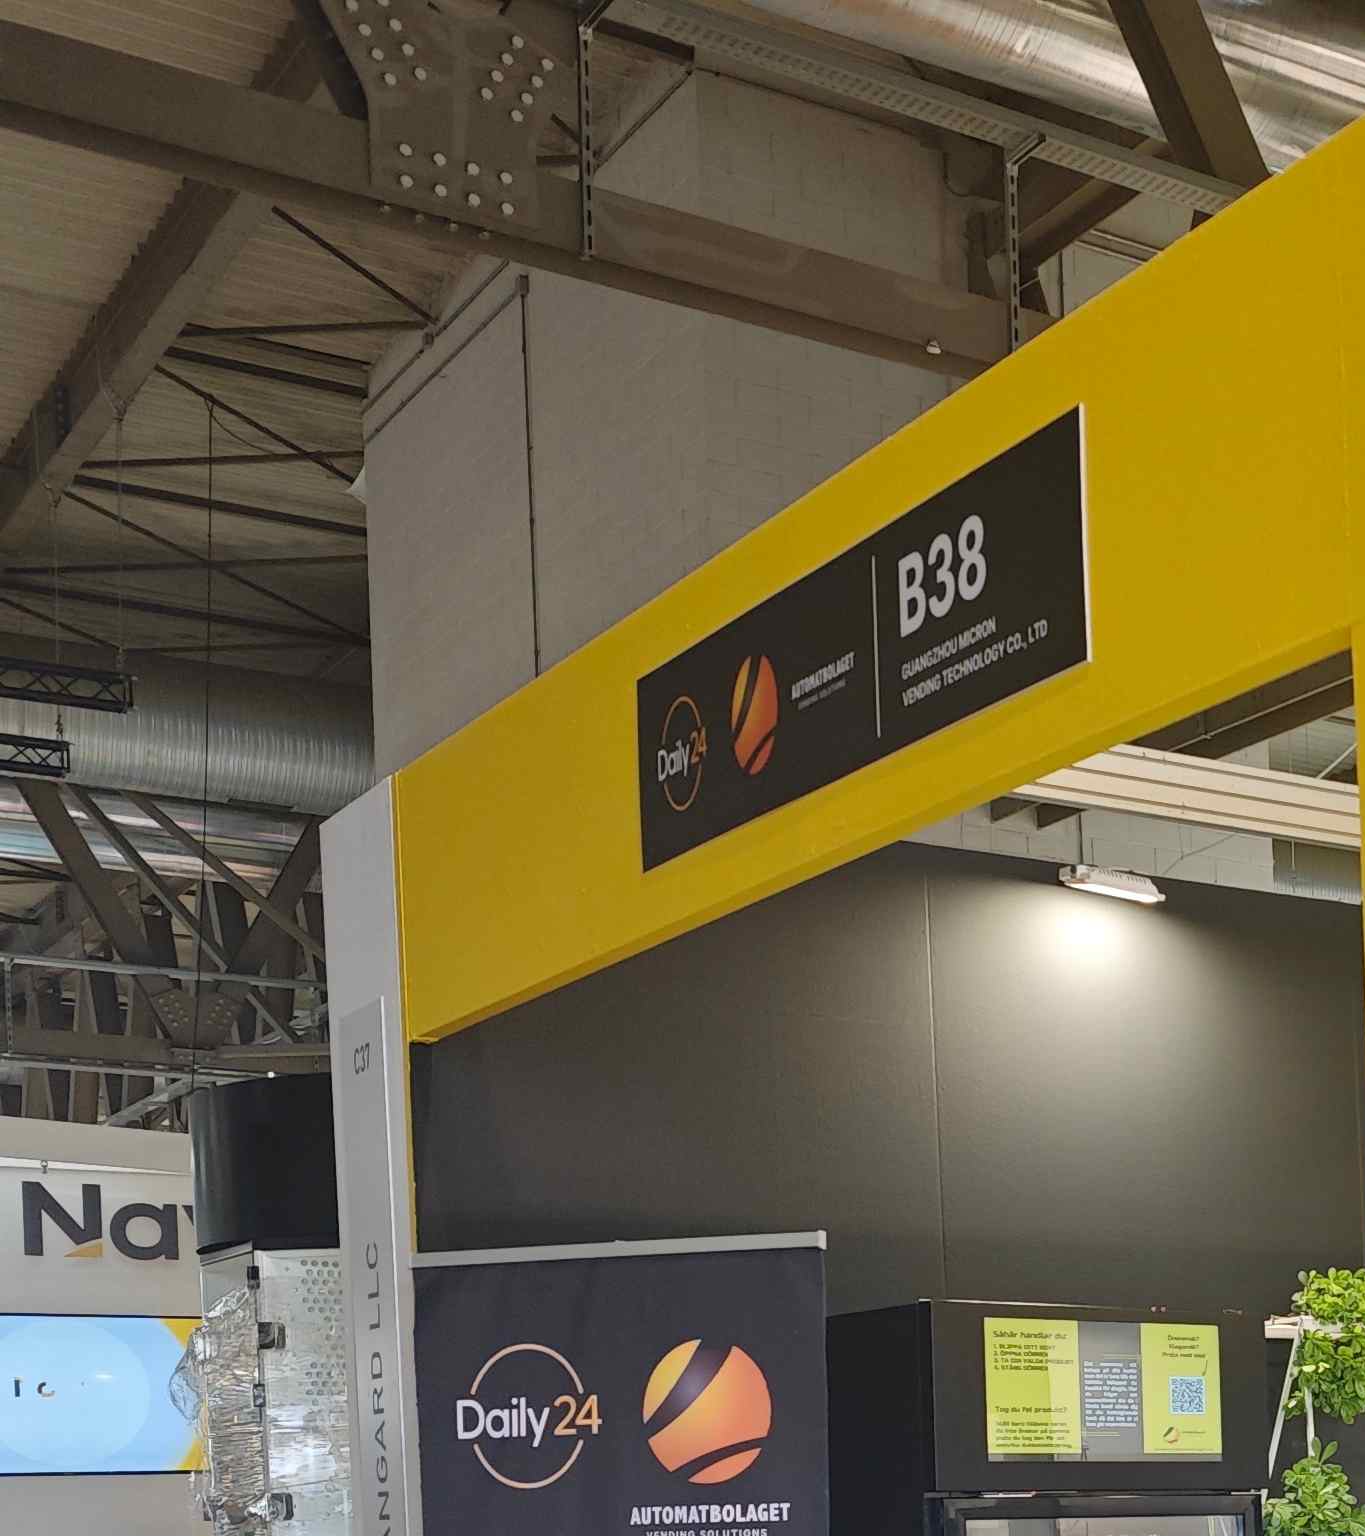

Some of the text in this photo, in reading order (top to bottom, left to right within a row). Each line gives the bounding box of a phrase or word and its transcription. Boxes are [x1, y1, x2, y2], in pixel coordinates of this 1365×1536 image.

[899, 514, 987, 639] B38
[901, 615, 997, 681] GUANGZHOU MICRON
[901, 673, 942, 707] VENDING
[942, 640, 1006, 687] TECHNOLOGY
[1027, 618, 1049, 644] LTD
[353, 1041, 371, 1076] C37
[21, 1180, 196, 1261] Na
[366, 1239, 384, 1331] LLC
[456, 1393, 603, 1448] Daily24
[629, 1501, 791, 1527] AUTOMATBOLAGET
